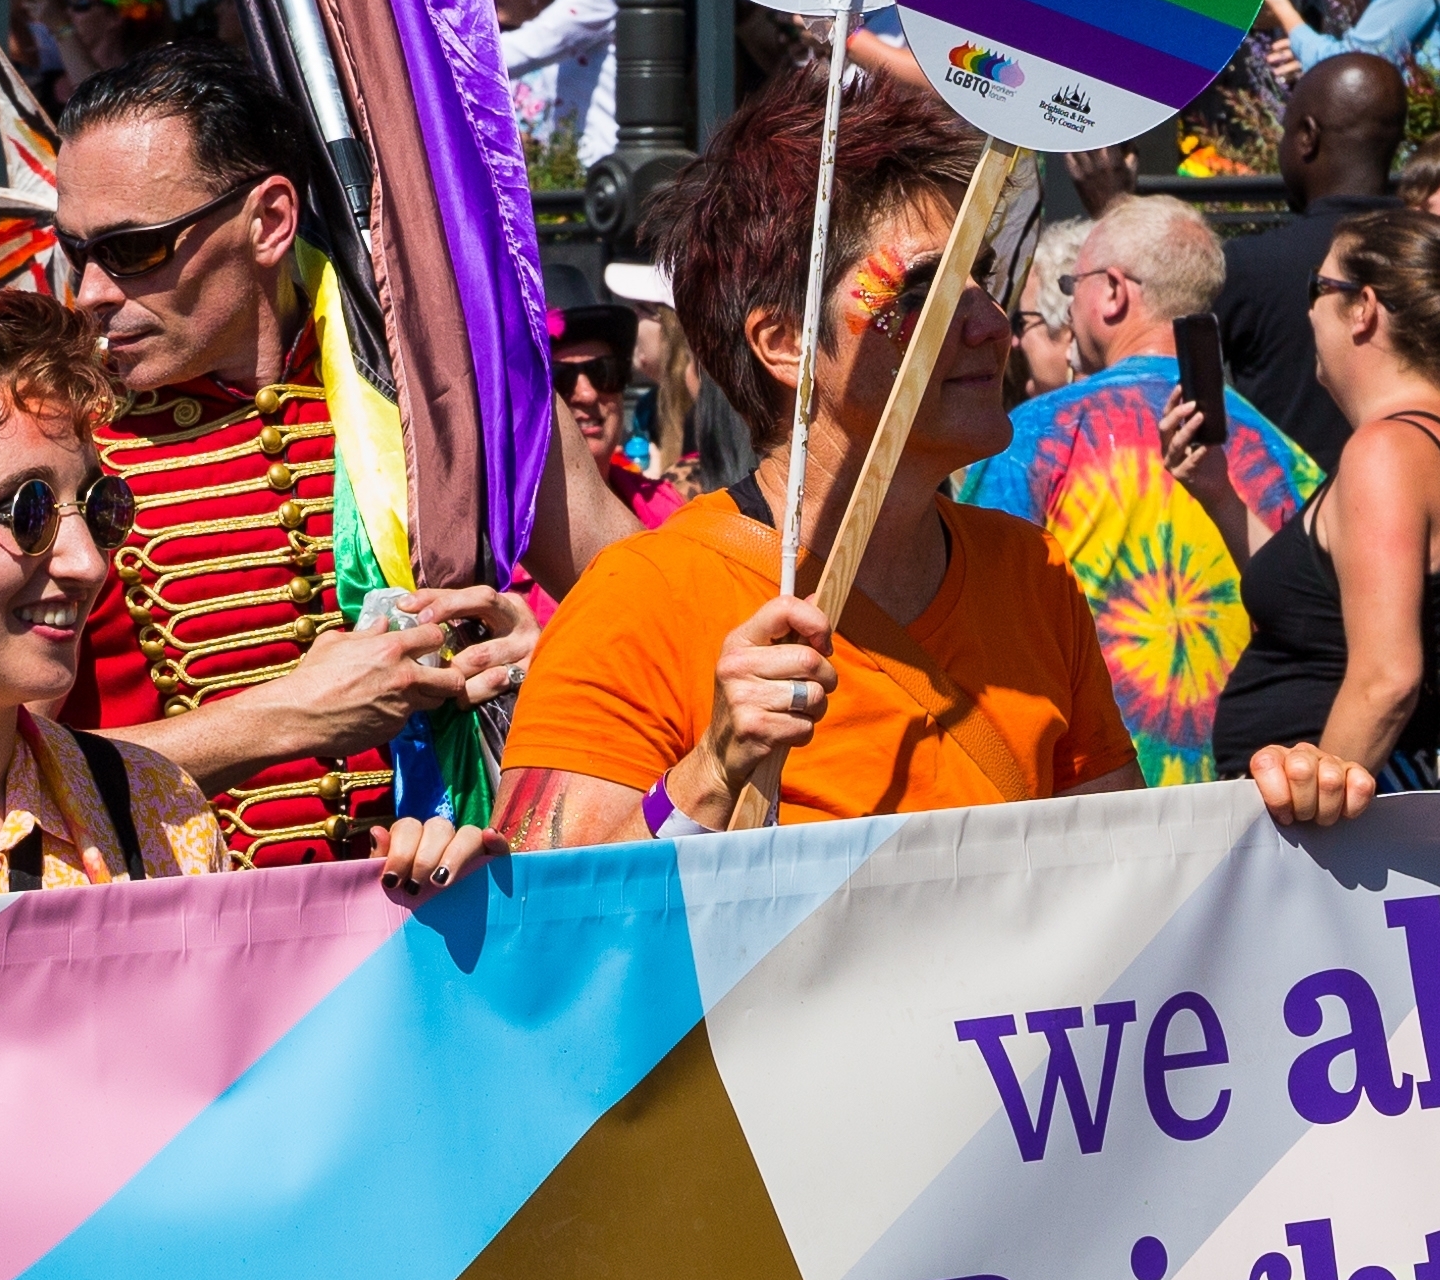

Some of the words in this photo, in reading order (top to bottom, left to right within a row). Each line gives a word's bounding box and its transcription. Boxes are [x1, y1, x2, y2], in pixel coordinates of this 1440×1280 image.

[945, 66, 991, 98] LGBTQ
[1038, 100, 1069, 118] Brighton
[1077, 114, 1096, 128] Hove
[1043, 111, 1058, 125] City
[1058, 118, 1086, 133] Council
[956, 991, 1231, 1162] we
